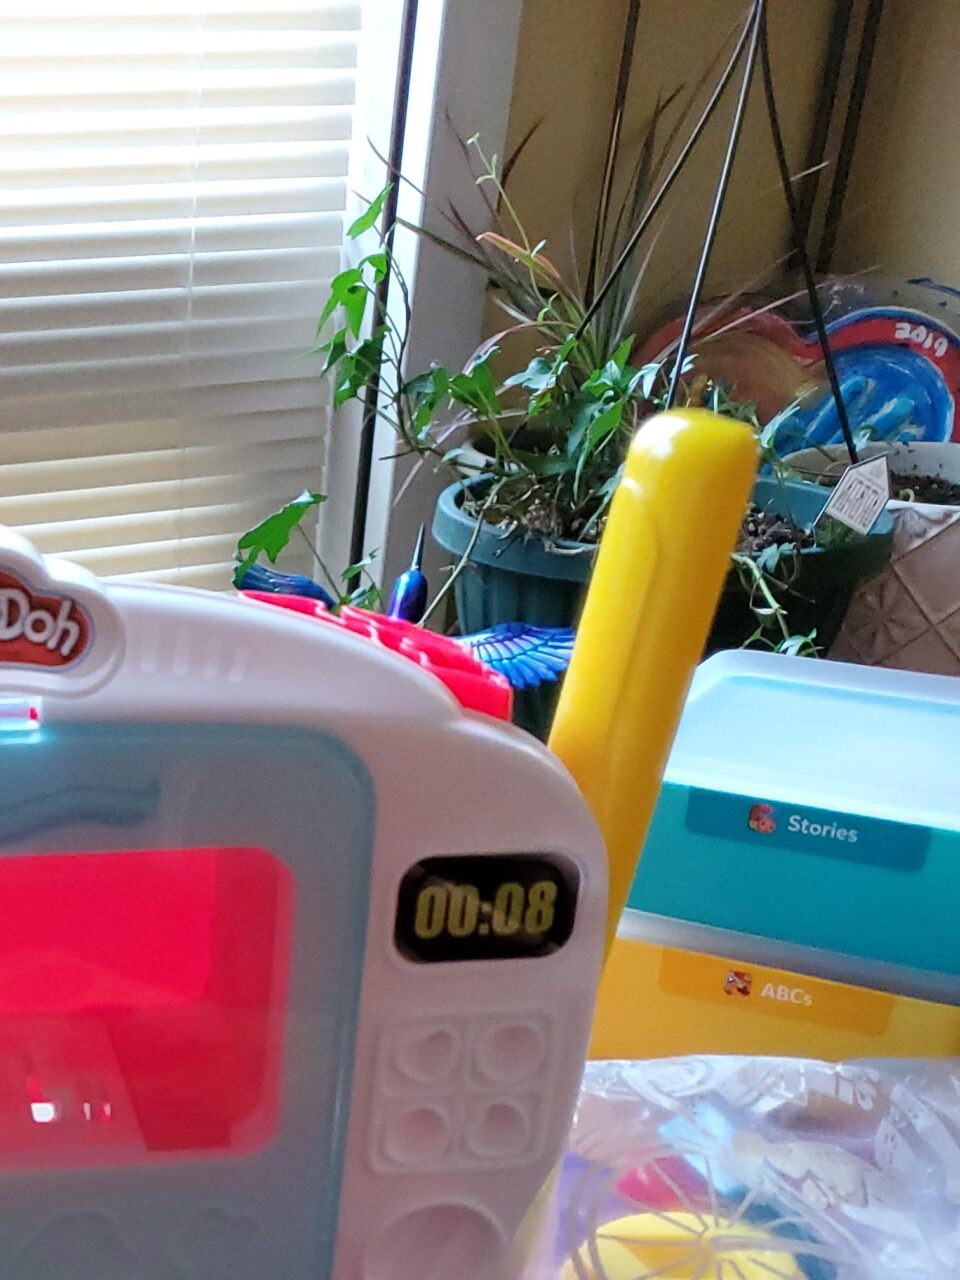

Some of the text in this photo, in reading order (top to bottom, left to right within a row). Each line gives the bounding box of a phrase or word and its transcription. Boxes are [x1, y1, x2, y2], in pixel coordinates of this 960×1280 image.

[895, 322, 948, 357] 2019
[787, 814, 859, 843] Stories
[414, 880, 558, 940] 00:08
[760, 982, 814, 1007] ABCs
